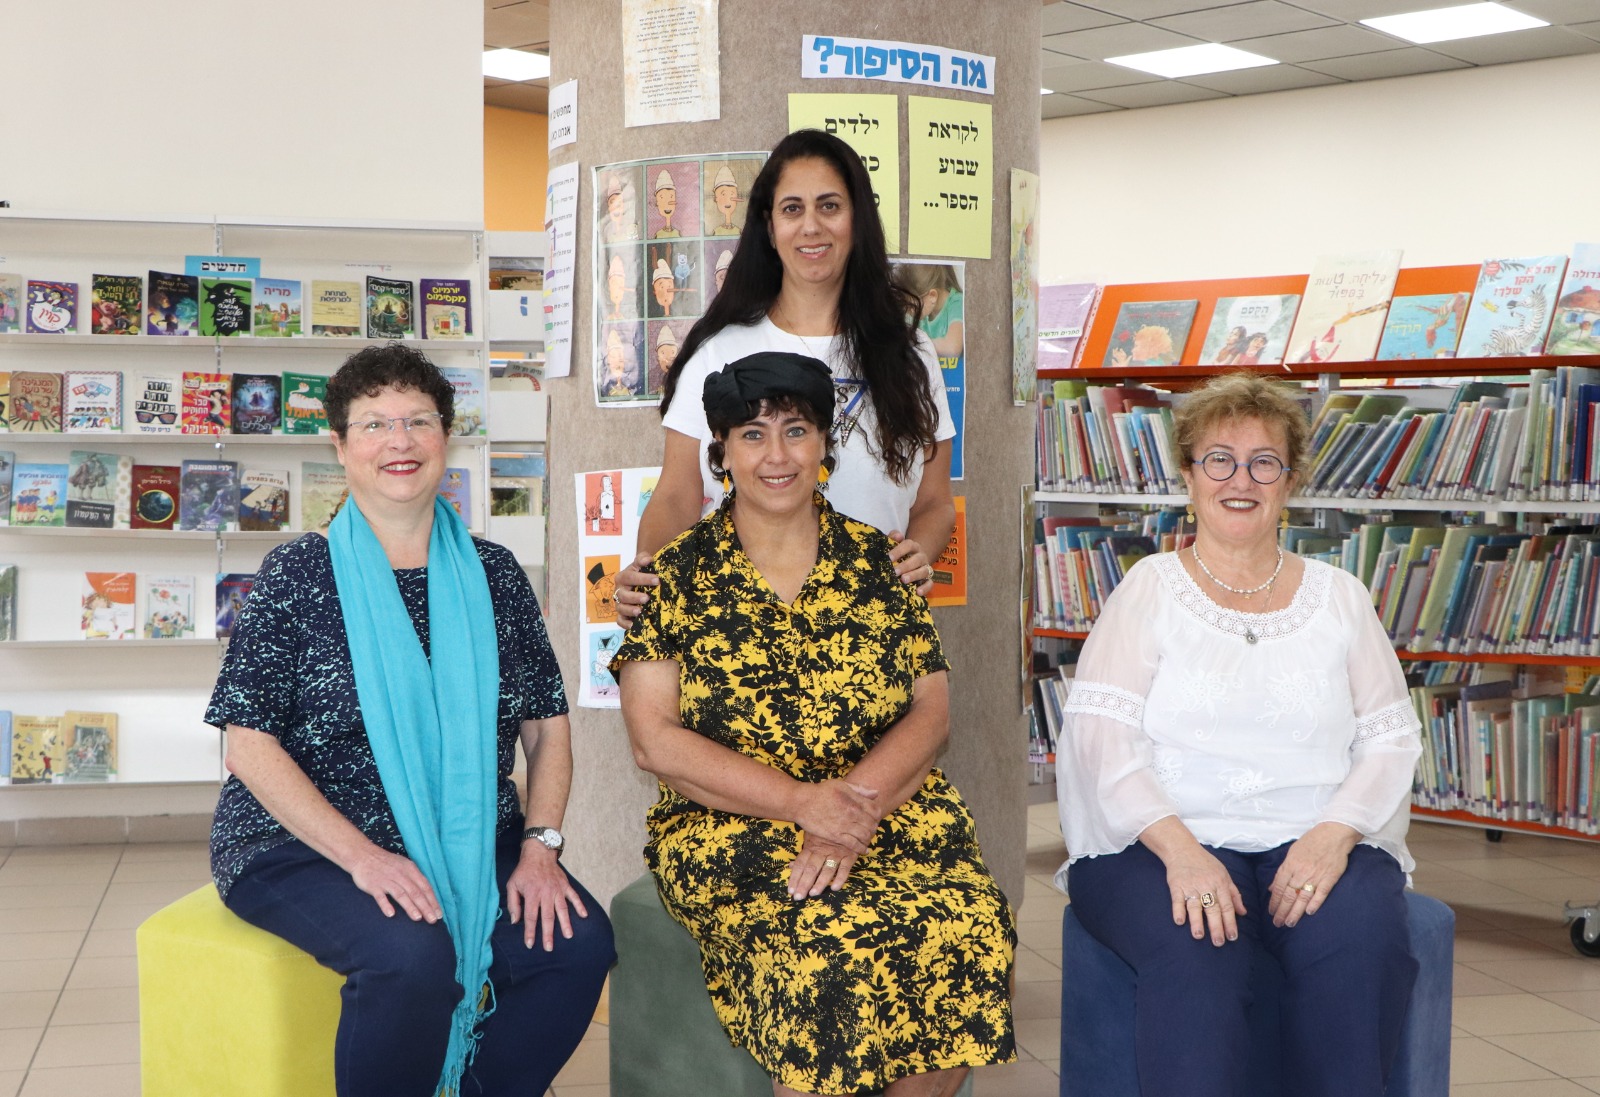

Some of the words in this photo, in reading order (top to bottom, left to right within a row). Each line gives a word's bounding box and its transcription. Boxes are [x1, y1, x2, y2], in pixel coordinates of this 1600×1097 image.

[812, 37, 941, 82] הסיפור?
[951, 56, 987, 89] מה
[824, 113, 879, 135] ילדים
[928, 120, 978, 144] לקראת
[939, 157, 979, 177] שבוע
[923, 192, 979, 210] הספר...
[201, 262, 246, 271] חדשים
[264, 287, 291, 297] מריה
[426, 293, 467, 303] מקסימוס
[1241, 306, 1269, 315] הקסם
[183, 406, 208, 414] החוקים
